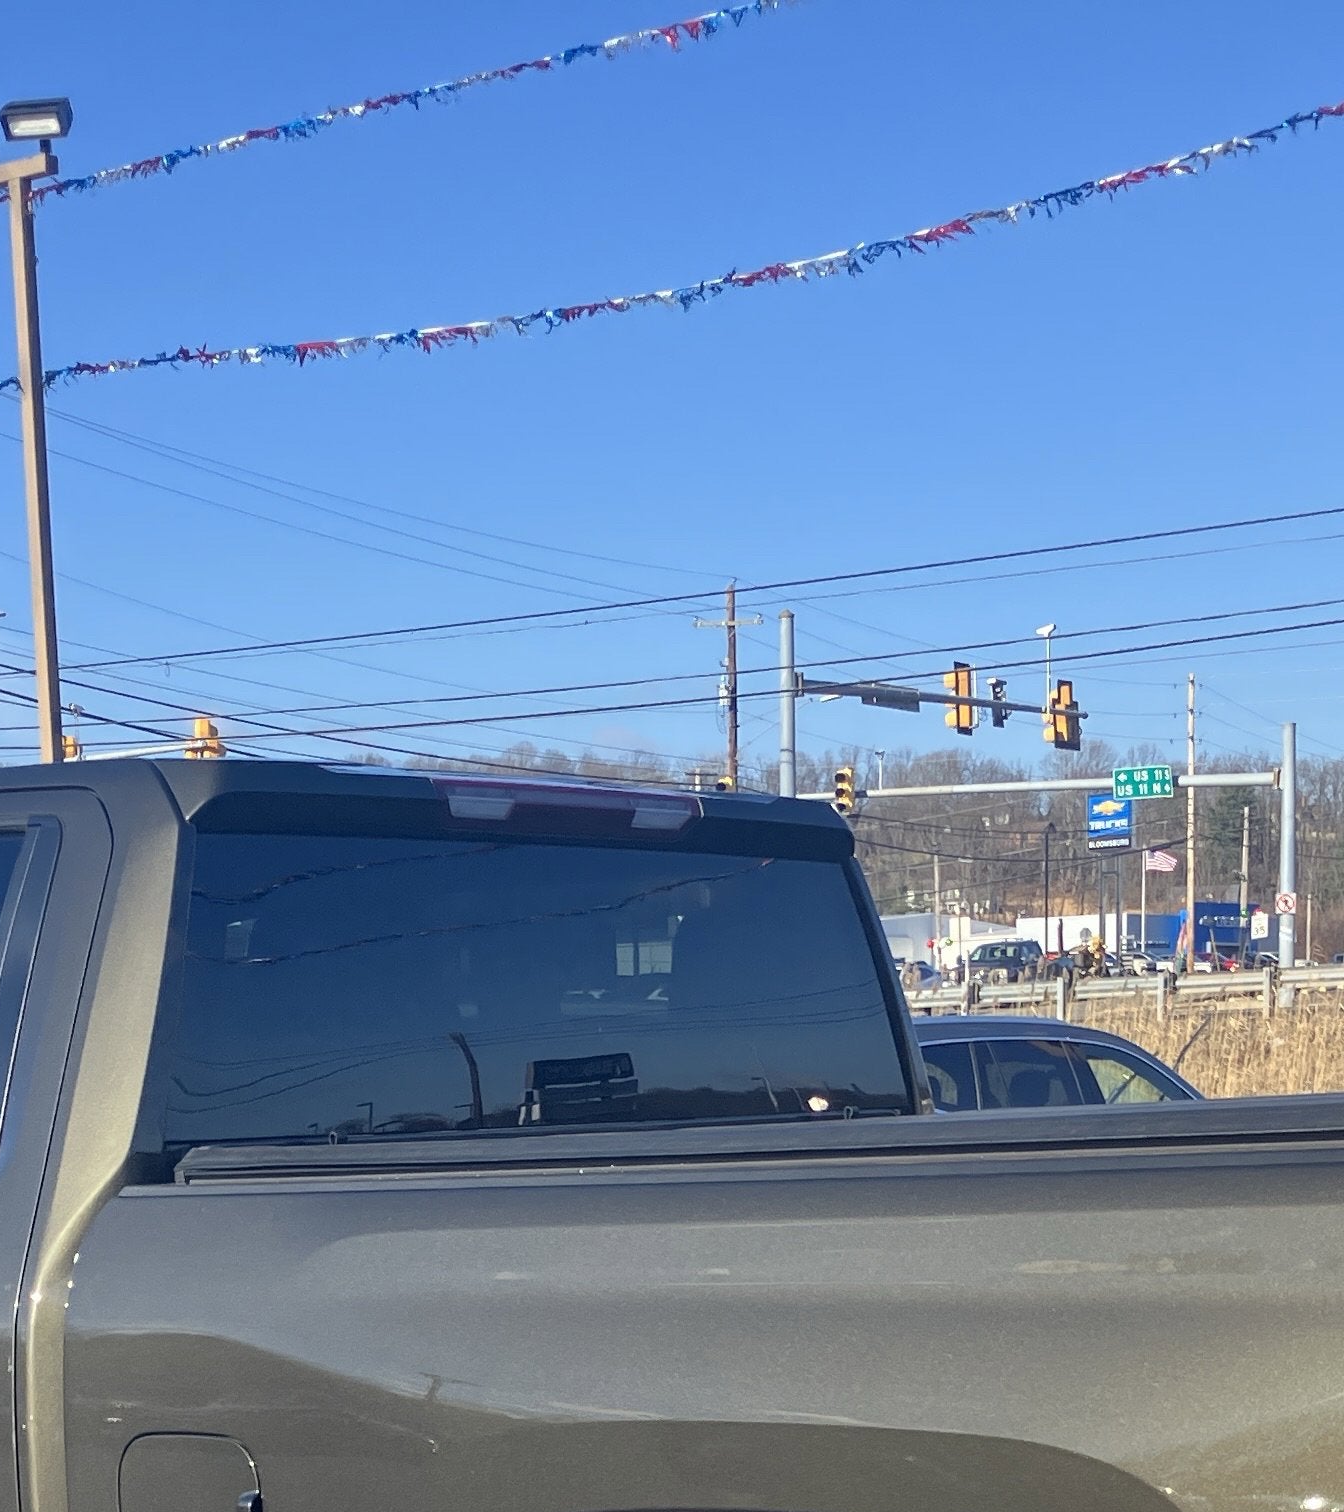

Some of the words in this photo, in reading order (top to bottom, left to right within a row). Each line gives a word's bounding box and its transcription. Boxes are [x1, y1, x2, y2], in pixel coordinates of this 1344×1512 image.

[1133, 770, 1149, 782] US
[1117, 784, 1134, 797] US
[1152, 781, 1162, 794] N
